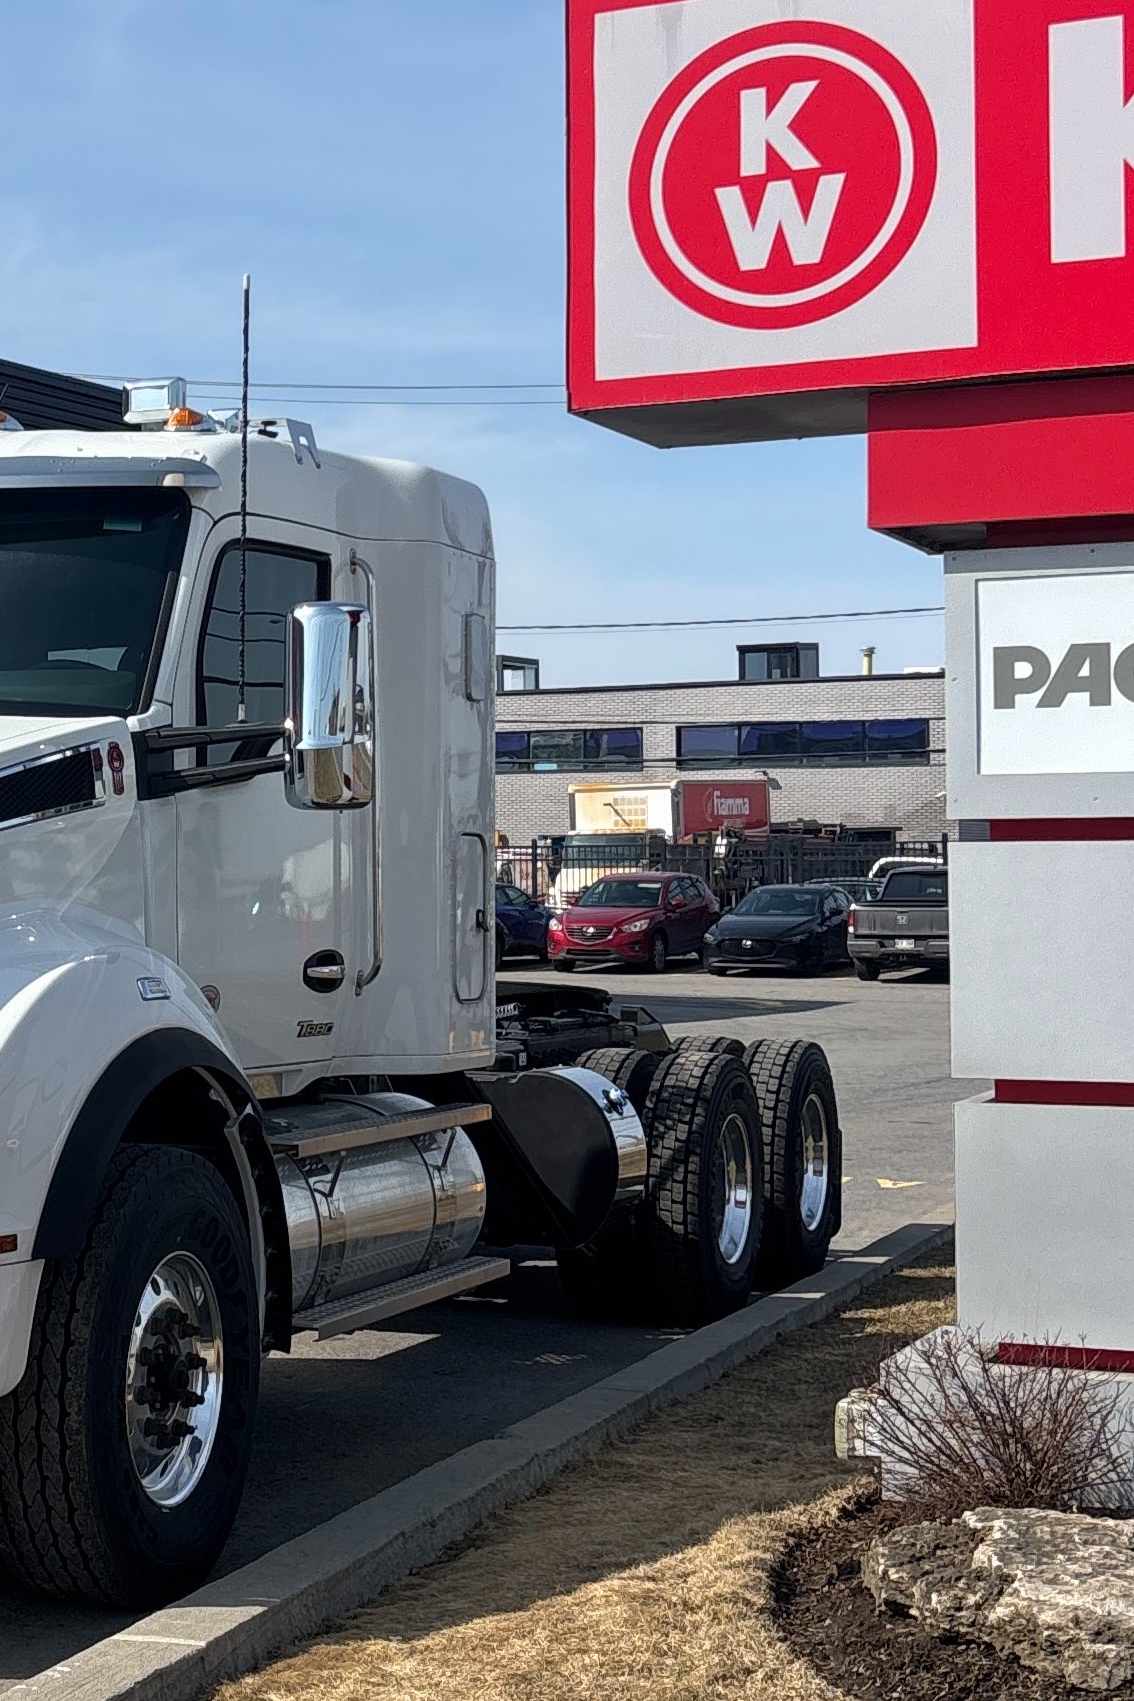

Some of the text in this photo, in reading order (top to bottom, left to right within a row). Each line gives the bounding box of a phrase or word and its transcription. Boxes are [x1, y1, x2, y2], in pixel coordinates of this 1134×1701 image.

[739, 79, 822, 178] K
[714, 172, 847, 272] W
[296, 1019, 335, 1038] T880
